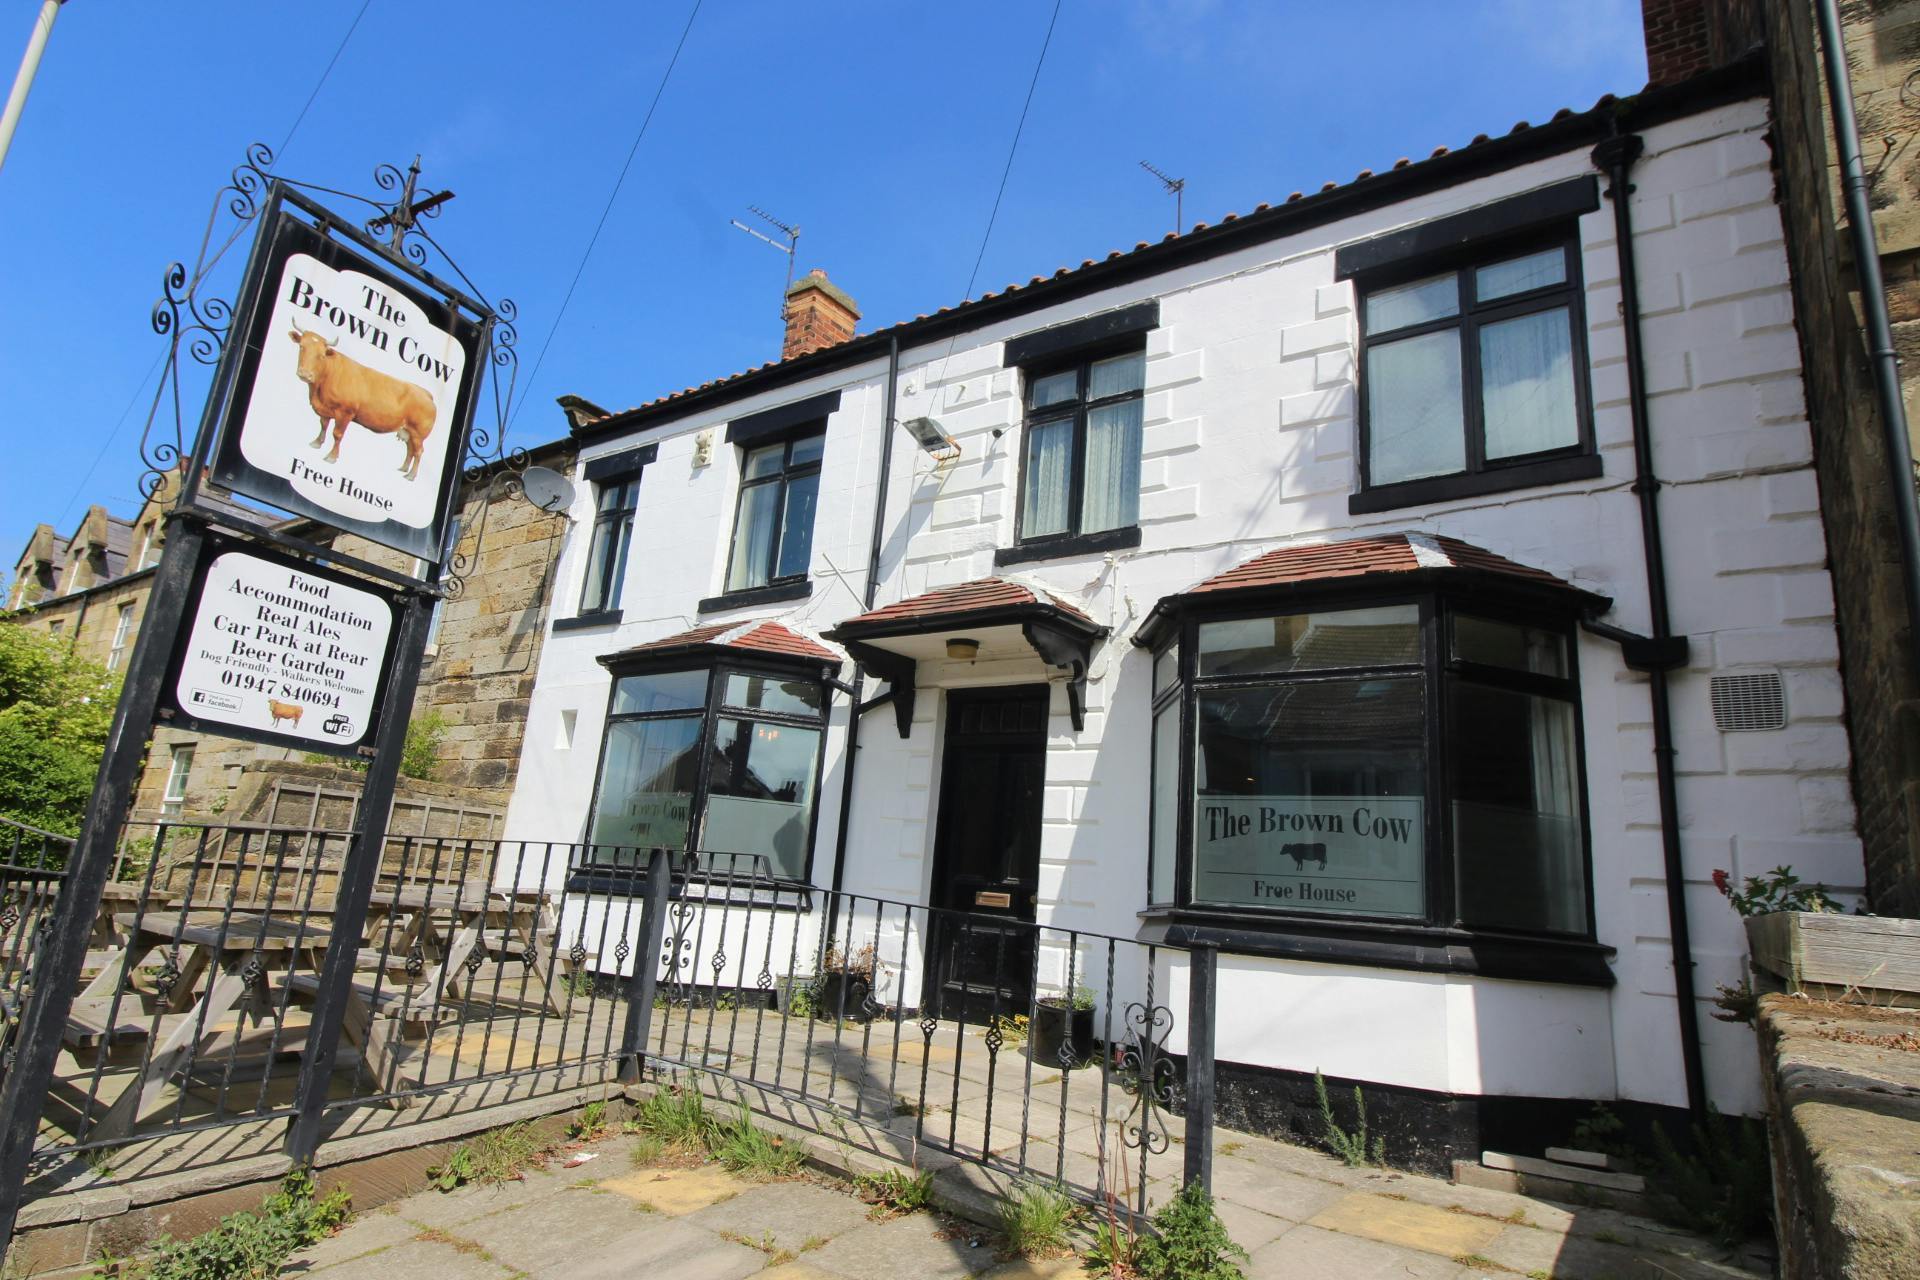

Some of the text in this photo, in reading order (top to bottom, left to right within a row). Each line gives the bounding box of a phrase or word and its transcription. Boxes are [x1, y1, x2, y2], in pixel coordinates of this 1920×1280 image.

[362, 285, 407, 328] The
[287, 276, 455, 384] Brown Cow
[289, 457, 393, 512] Free House
[228, 578, 373, 631] Accommodation
[288, 574, 330, 599] Food
[213, 614, 368, 667] Car Park at Rear
[255, 605, 341, 641] Real Ales
[200, 649, 222, 665] Dog
[225, 656, 272, 676] Friendly
[281, 668, 321, 689] Walkers
[324, 677, 365, 696] Welcome
[231, 639, 345, 681] Beer Garden
[208, 699, 237, 709] facebook
[221, 669, 341, 710] 01947 840694
[1205, 806, 1412, 844] The Brown Cow
[1253, 880, 1356, 902] Free House
